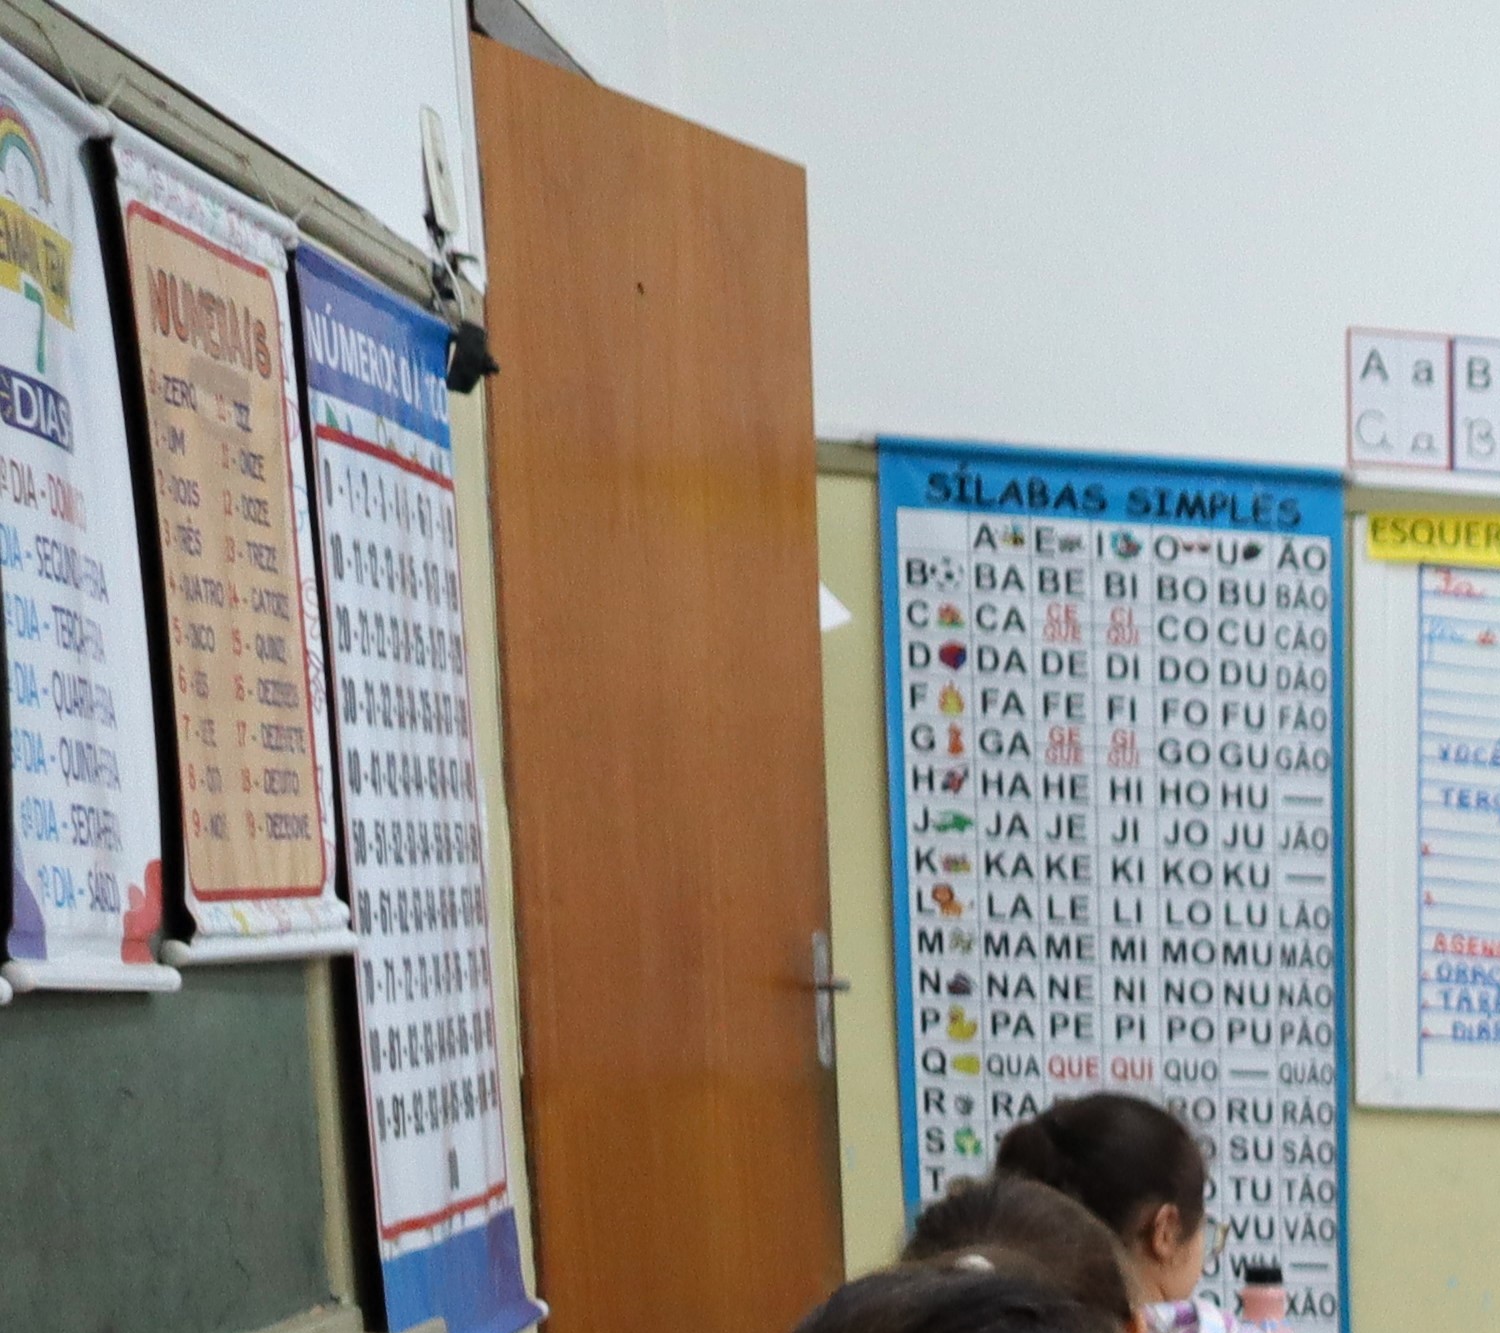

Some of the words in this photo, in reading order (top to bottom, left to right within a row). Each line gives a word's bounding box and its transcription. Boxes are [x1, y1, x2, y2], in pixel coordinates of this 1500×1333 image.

[15, 380, 71, 445] DIAS
[927, 465, 1108, 519] SÍLABAS
[1126, 491, 1301, 532] SIMPLES
[974, 524, 996, 550] A
[1036, 528, 1056, 554] E
[1154, 539, 1179, 561] O
[1218, 542, 1238, 566] U
[1278, 540, 1326, 571] ÃO
[906, 560, 929, 585] B
[975, 564, 1025, 592] BA
[1038, 567, 1084, 595] BE
[1104, 572, 1137, 599] BI
[1156, 576, 1207, 604] BO
[1219, 579, 1265, 608] BU
[1277, 582, 1327, 611] BÃO
[907, 600, 929, 627] C
[976, 605, 1025, 633] CA
[1158, 615, 1209, 644] CO
[1218, 620, 1266, 648] CU
[1276, 622, 1327, 651] CÃO
[909, 642, 931, 668] D
[978, 646, 1027, 675] DA
[1042, 650, 1089, 678] DE
[1107, 654, 1140, 680] DI
[1159, 657, 1209, 685] DO
[1220, 661, 1267, 689] DU
[1277, 664, 1327, 691] DÃO
[910, 684, 927, 709] F
[982, 689, 1025, 716] FA
[1043, 692, 1089, 719] FE
[1108, 696, 1136, 723] FI
[1162, 699, 1208, 726] FO
[1223, 703, 1265, 731] FU
[1280, 702, 1327, 732] FÃO
[911, 726, 936, 751] G
[979, 729, 1031, 757] GA
[1158, 740, 1211, 766] GO
[1220, 743, 1269, 769] GU
[1275, 743, 1330, 772] GÃO
[913, 768, 935, 791] H
[981, 771, 1031, 798] HA
[1043, 774, 1089, 801] HE
[1110, 778, 1143, 804] HI
[1160, 780, 1209, 807] HO
[1222, 784, 1269, 810] HU
[914, 808, 930, 833] J
[986, 811, 1029, 839] JA
[1046, 814, 1089, 840] JE
[1112, 817, 1139, 843] JI
[1164, 820, 1208, 847] JO
[1223, 824, 1264, 849] JU
[1282, 822, 1328, 851] JÃO
[916, 848, 937, 873] K
[985, 852, 1034, 878] KA
[1046, 855, 1089, 881] KE
[1112, 858, 1145, 883] KI
[1164, 860, 1213, 886] KO
[1224, 862, 1269, 889] KU
[917, 889, 931, 913] L
[988, 892, 1033, 919] LA
[1048, 896, 1089, 921] LE
[1114, 899, 1143, 924] LI
[1167, 900, 1211, 925] LO
[1224, 902, 1267, 927] LU
[1280, 900, 1330, 929] LÃO
[918, 930, 943, 954] M
[984, 932, 1037, 959] MA
[1046, 935, 1094, 960] ME
[1111, 937, 1147, 963] MI
[1162, 938, 1216, 964] MO
[1222, 942, 1272, 967] MU
[1281, 939, 1333, 968] MÃO
[919, 970, 941, 995] N
[988, 973, 1036, 999] NA
[1049, 976, 1093, 1001] NE
[1114, 977, 1146, 1003] NI
[1164, 979, 1214, 1005] NO
[1224, 982, 1270, 1007] NU
[1279, 979, 1333, 1008] NÃO
